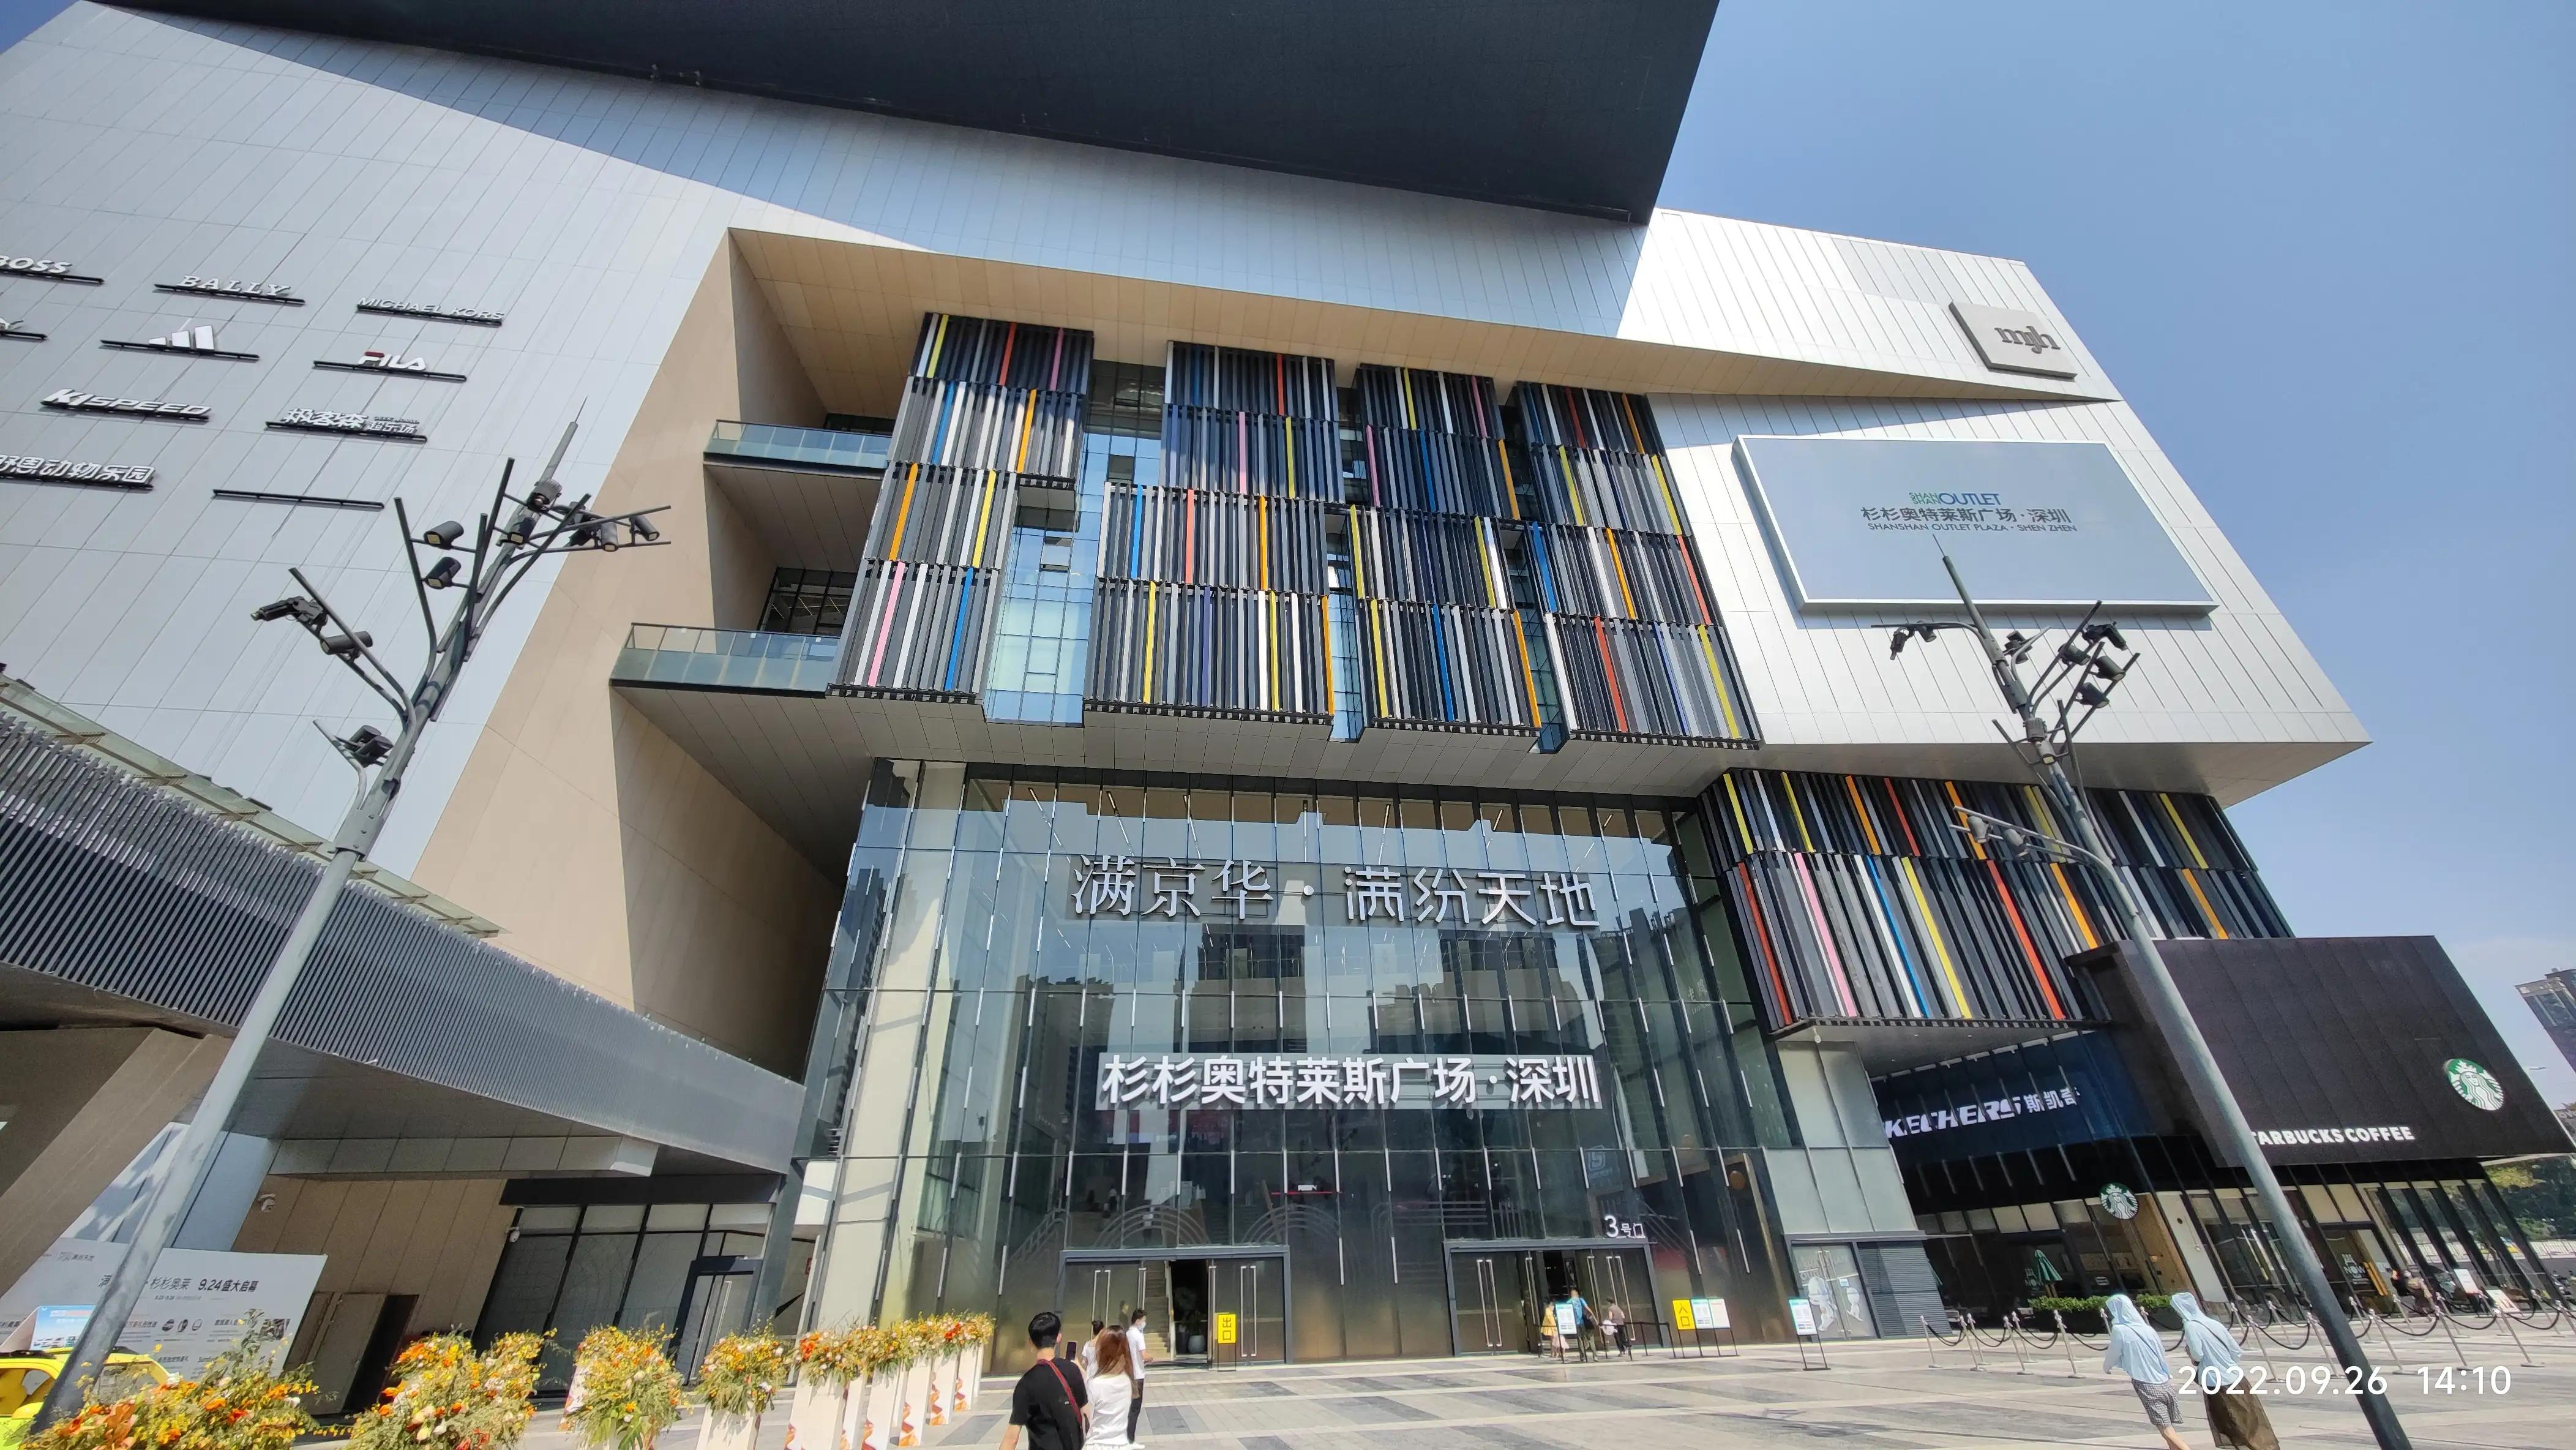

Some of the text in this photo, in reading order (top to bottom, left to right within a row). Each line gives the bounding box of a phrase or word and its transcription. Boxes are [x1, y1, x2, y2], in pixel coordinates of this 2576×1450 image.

[177, 275, 291, 296] BALLY
[357, 296, 505, 320] MICHAEL KORS
[358, 351, 427, 371] FILA
[1939, 492, 2002, 506] OUTLET
[1860, 507, 2072, 524] 杉杉奥特莱斯广场·深圳
[1931, 523, 1971, 532] OUTLET
[1103, 1054, 1602, 1105] 杉杉奥特莱斯广场·深圳
[1883, 1097, 2021, 1139] KECHERS
[2252, 1126, 2415, 1146] ARBUCKS COFFEE
[1679, 1302, 1691, 1328] 入口
[1222, 1316, 1232, 1340] 出口
